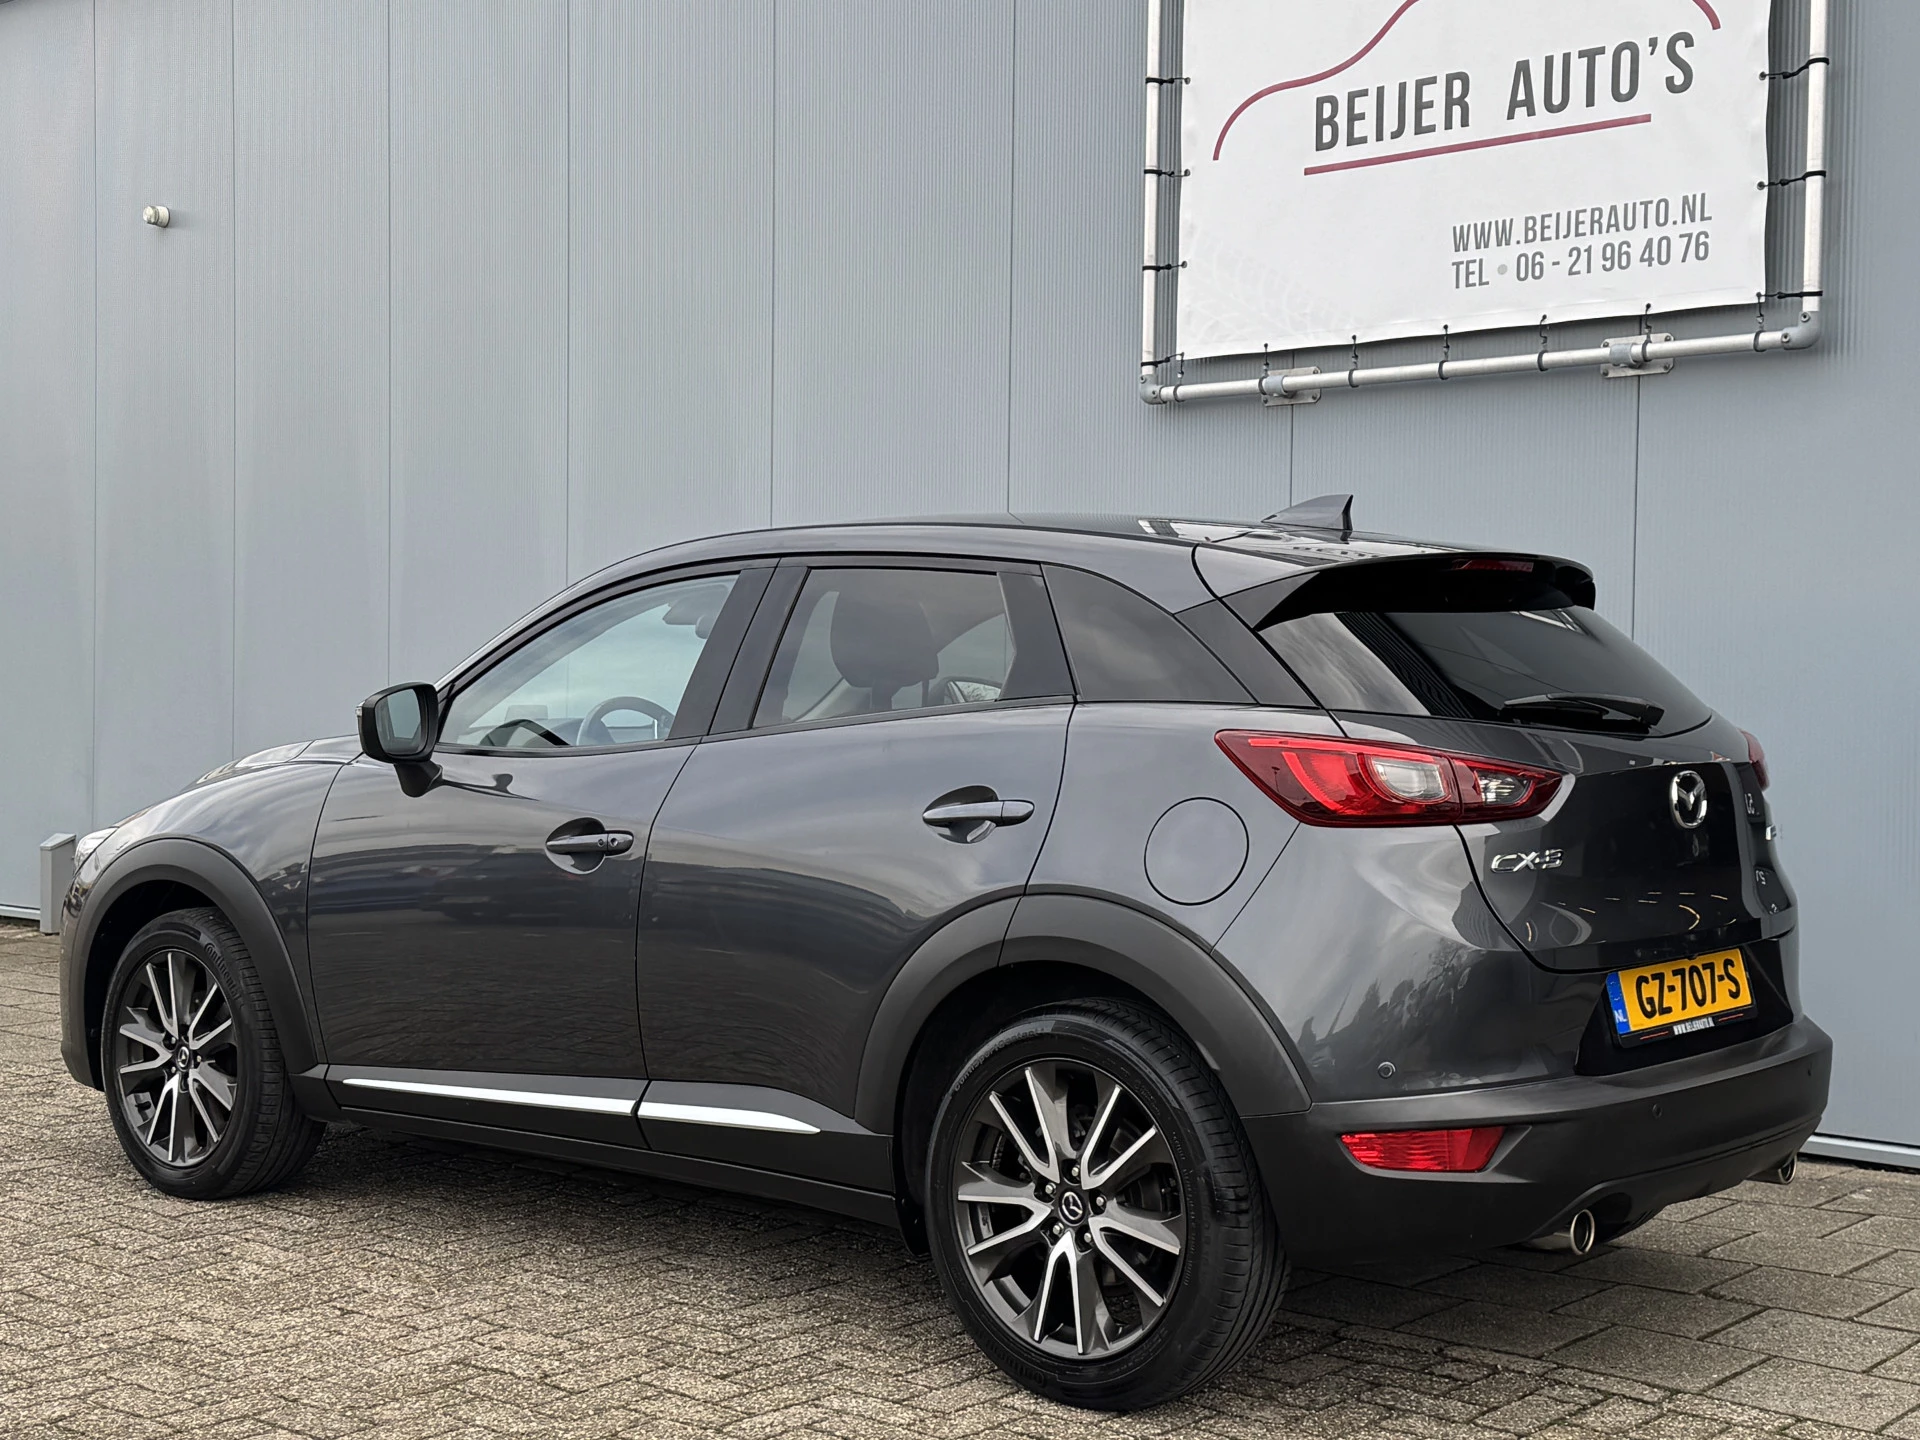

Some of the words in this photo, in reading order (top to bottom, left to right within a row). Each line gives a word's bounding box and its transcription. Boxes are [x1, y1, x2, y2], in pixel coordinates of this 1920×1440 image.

[1315, 71, 1471, 153] BEIJER
[1507, 31, 1695, 121] AUTO'S
[1452, 192, 1713, 253] WWW.BEIJERAUTO.NL
[1451, 257, 1490, 290] TEL
[1516, 251, 1545, 282] 06
[1567, 244, 1593, 277] 21
[1601, 240, 1632, 273] 96
[1640, 236, 1672, 268] 40
[1679, 230, 1710, 264] 76
[1490, 848, 1564, 873] CX-3
[1614, 1009, 1628, 1023] NL
[1635, 958, 1741, 1020] GZ-707-S
